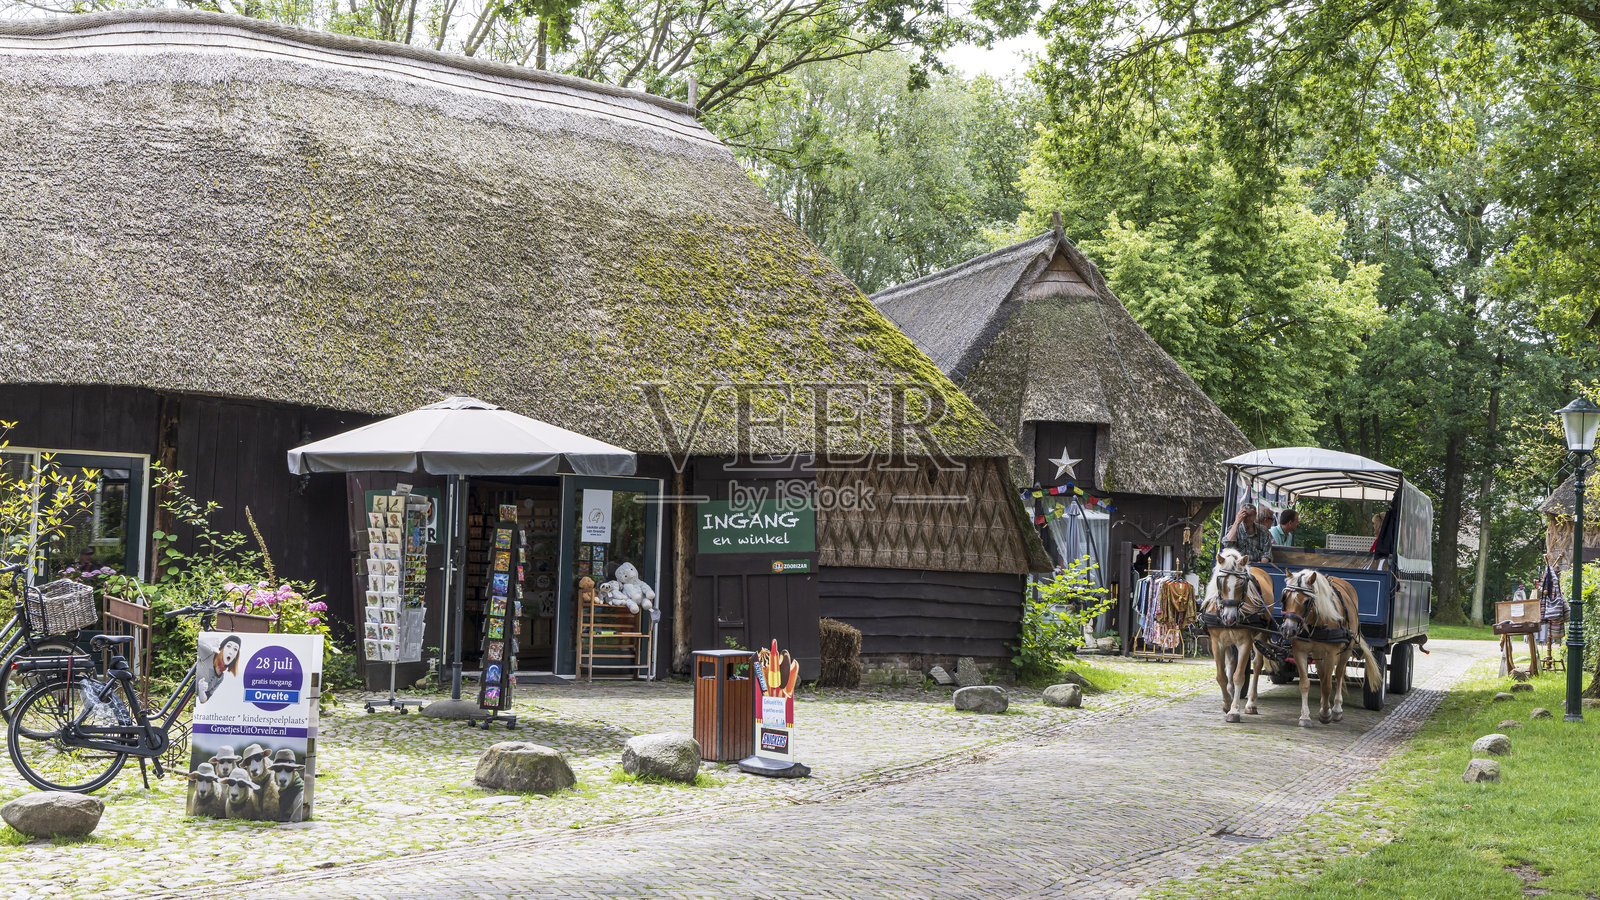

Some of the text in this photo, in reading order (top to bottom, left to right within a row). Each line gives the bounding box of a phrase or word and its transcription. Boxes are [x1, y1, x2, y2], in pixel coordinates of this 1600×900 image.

[702, 511, 800, 530] INGANG
[712, 532, 790, 546] en winkel
[255, 657, 293, 673] 28 juli
[252, 678, 268, 686] gratis
[254, 690, 289, 701] Orvelte
[193, 712, 236, 722] straattheater
[210, 724, 287, 736] GroetjesUitOrvelte.nl
[762, 733, 786, 747] SNICKERS
